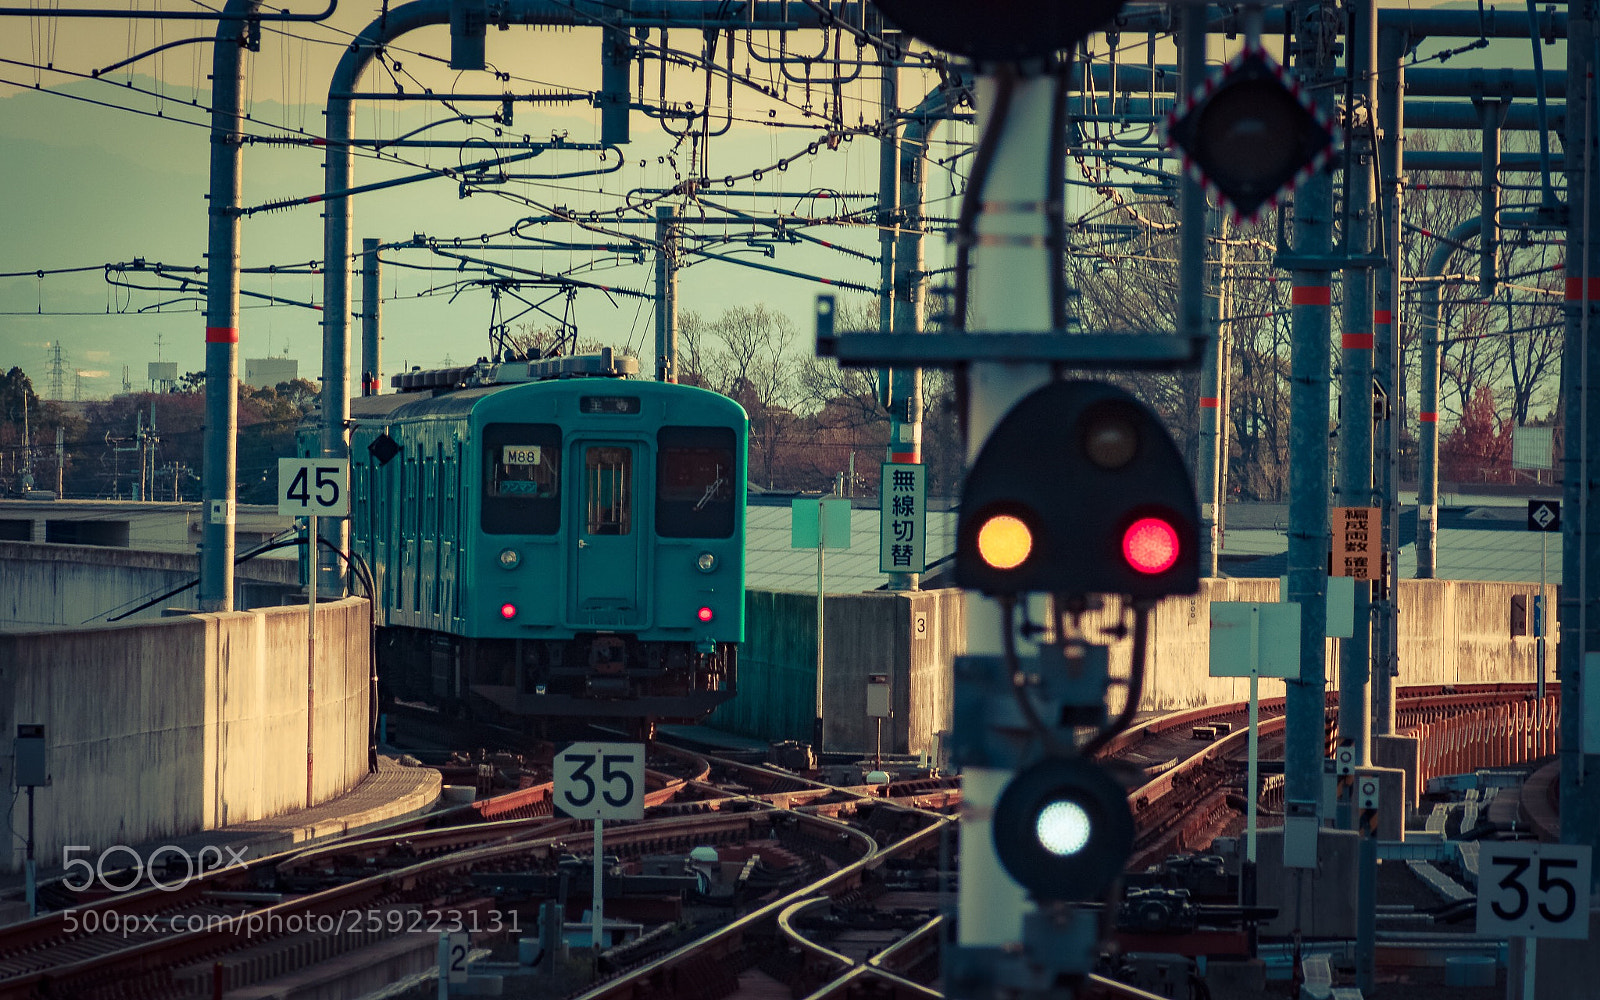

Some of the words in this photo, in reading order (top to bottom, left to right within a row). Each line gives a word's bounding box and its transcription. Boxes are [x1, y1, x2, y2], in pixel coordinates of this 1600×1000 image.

[508, 451, 535, 463] M88
[287, 467, 339, 507] 45
[892, 469, 915, 567] 無線切替
[1539, 508, 1549, 524] 2
[917, 618, 925, 633] 3
[564, 754, 634, 808] 35
[1491, 856, 1578, 924] 35
[451, 944, 465, 971] 2
